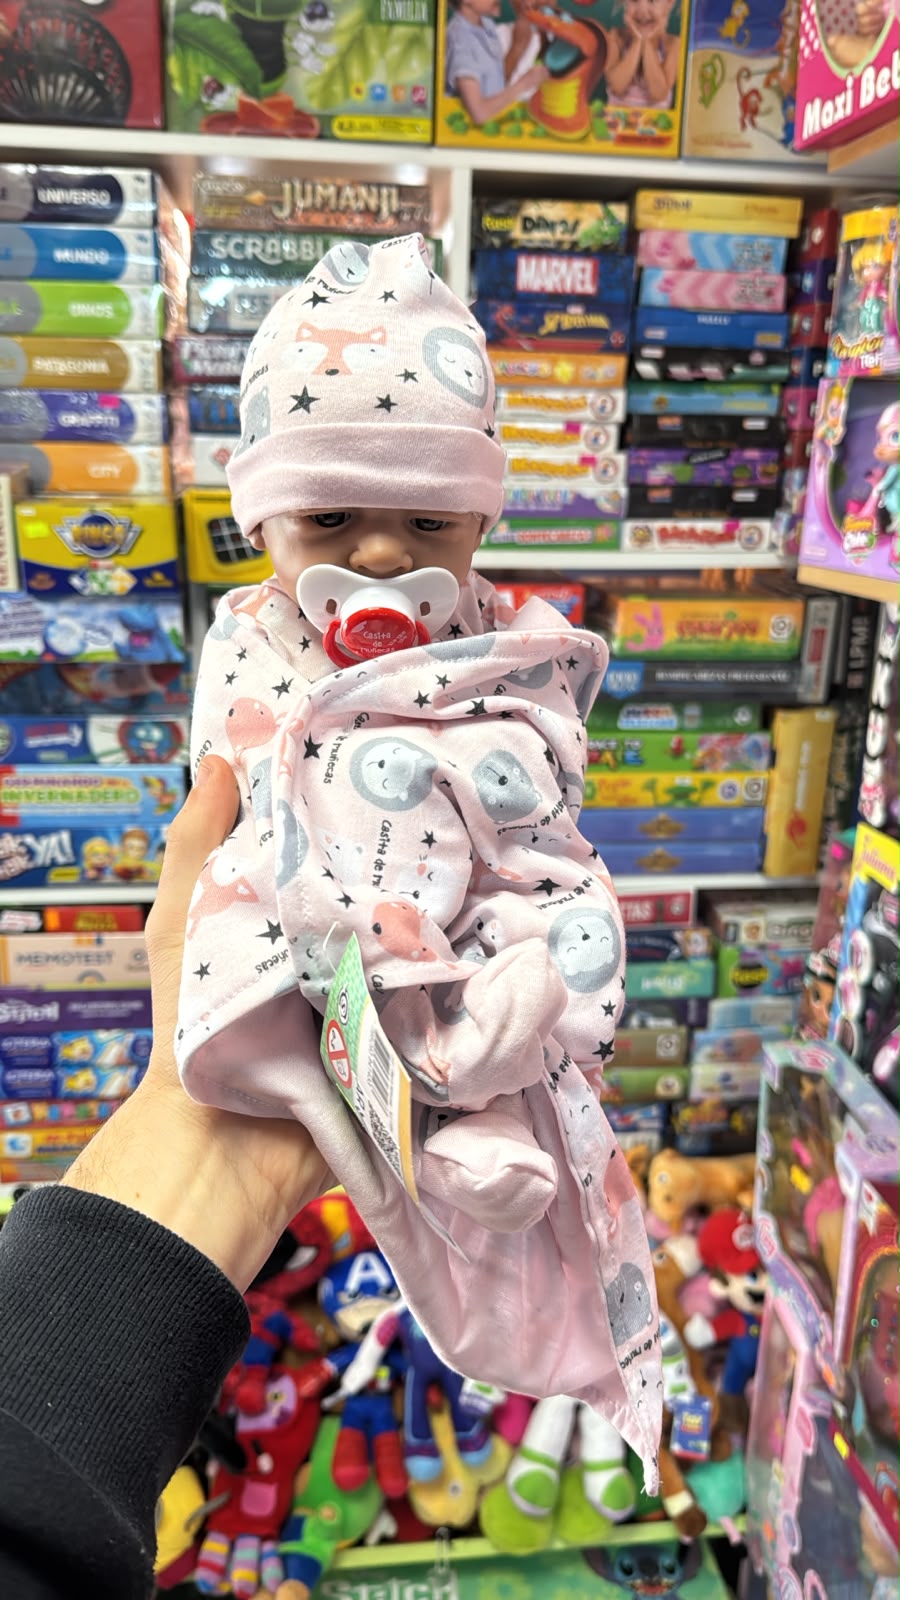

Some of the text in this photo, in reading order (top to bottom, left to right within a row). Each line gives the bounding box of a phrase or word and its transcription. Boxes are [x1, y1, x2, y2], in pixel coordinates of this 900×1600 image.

[802, 72, 854, 141] Maxi
[37, 187, 111, 206] UNIVERSO
[271, 181, 401, 220] JUMANJI
[53, 248, 110, 265] MUNDO
[210, 235, 326, 266] SCRABBL
[518, 257, 595, 294] MARVEL
[33, 358, 110, 374] PATAGONIA
[88, 463, 122, 479] CITY
[363, 631, 391, 640] Casita
[323, 743, 342, 785] muñecas
[1, 787, 140, 803] INVERNADERO
[375, 819, 393, 856] Casita
[372, 858, 387, 872] de
[16, 951, 113, 964] MEMOTEST
